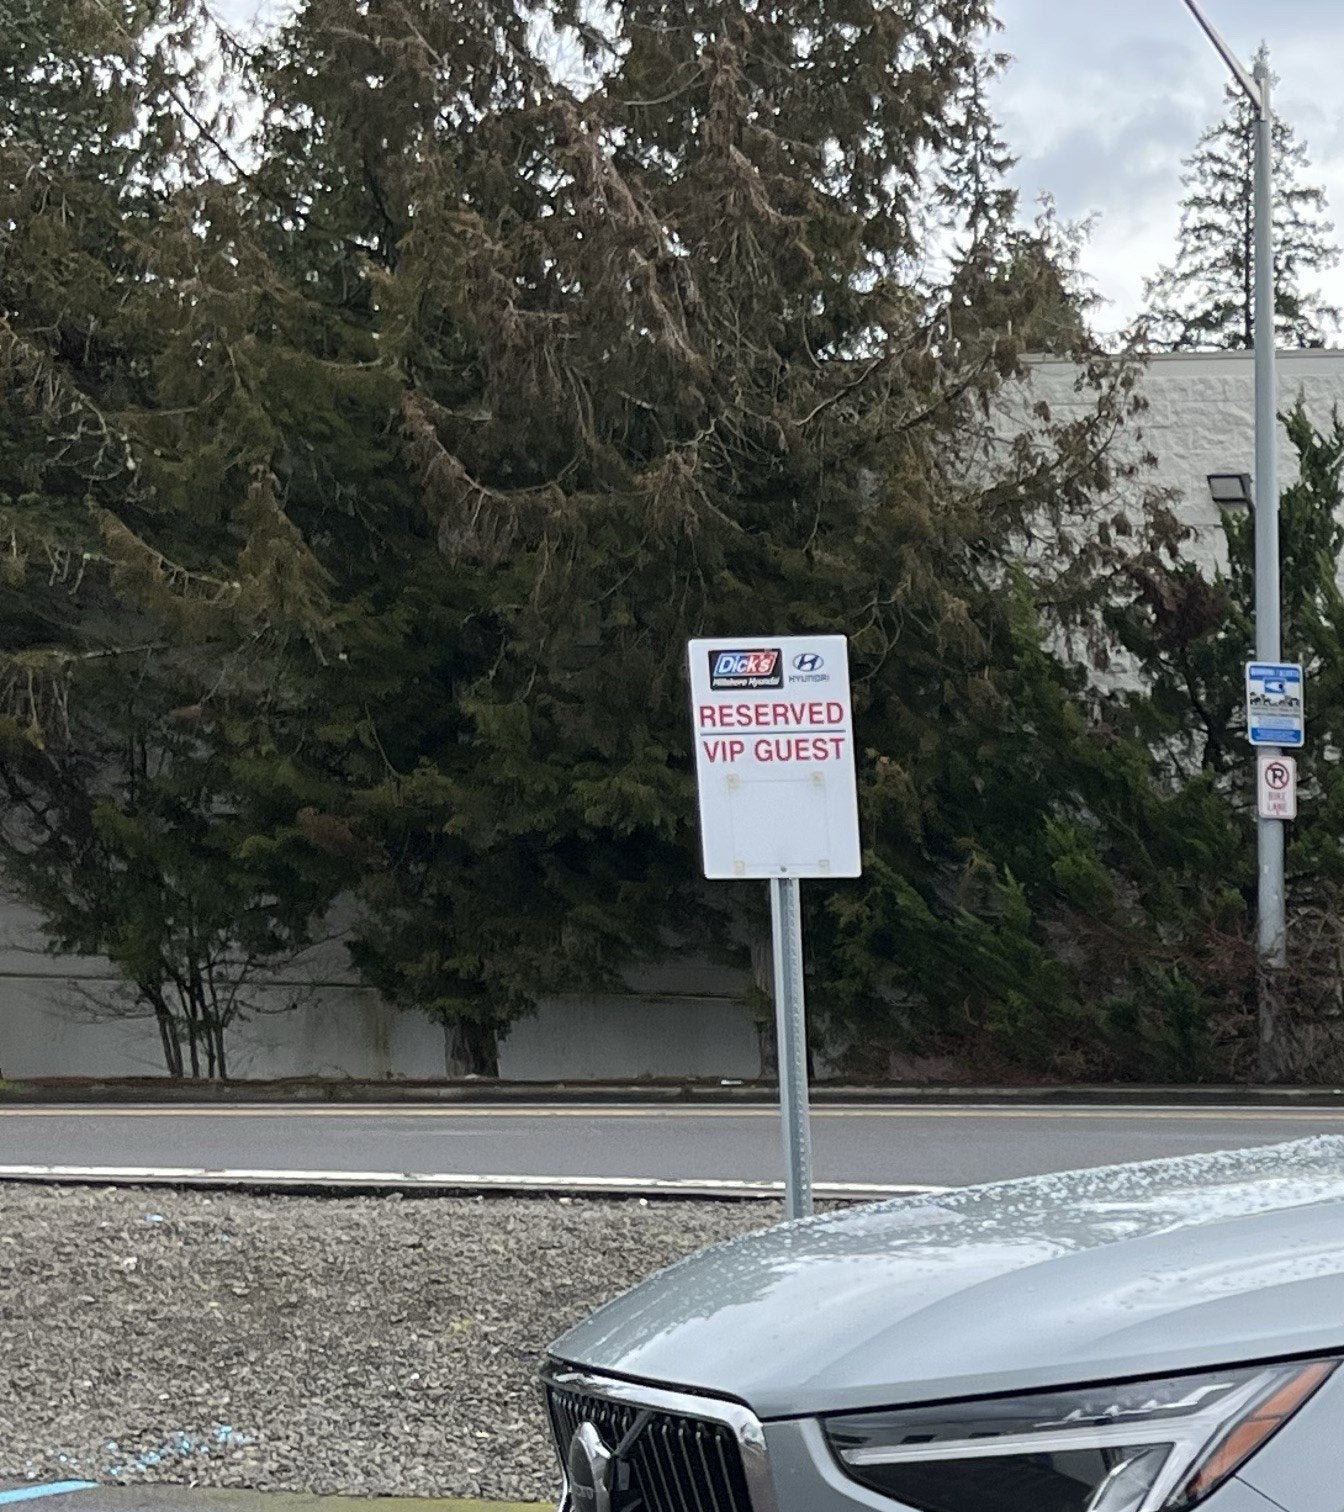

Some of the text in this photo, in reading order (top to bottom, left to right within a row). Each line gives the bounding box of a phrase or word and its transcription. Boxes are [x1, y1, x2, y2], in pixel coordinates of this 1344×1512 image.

[719, 655, 771, 673] Dick's
[700, 702, 843, 726] RESERVED
[704, 737, 845, 762] VIP GUEST
